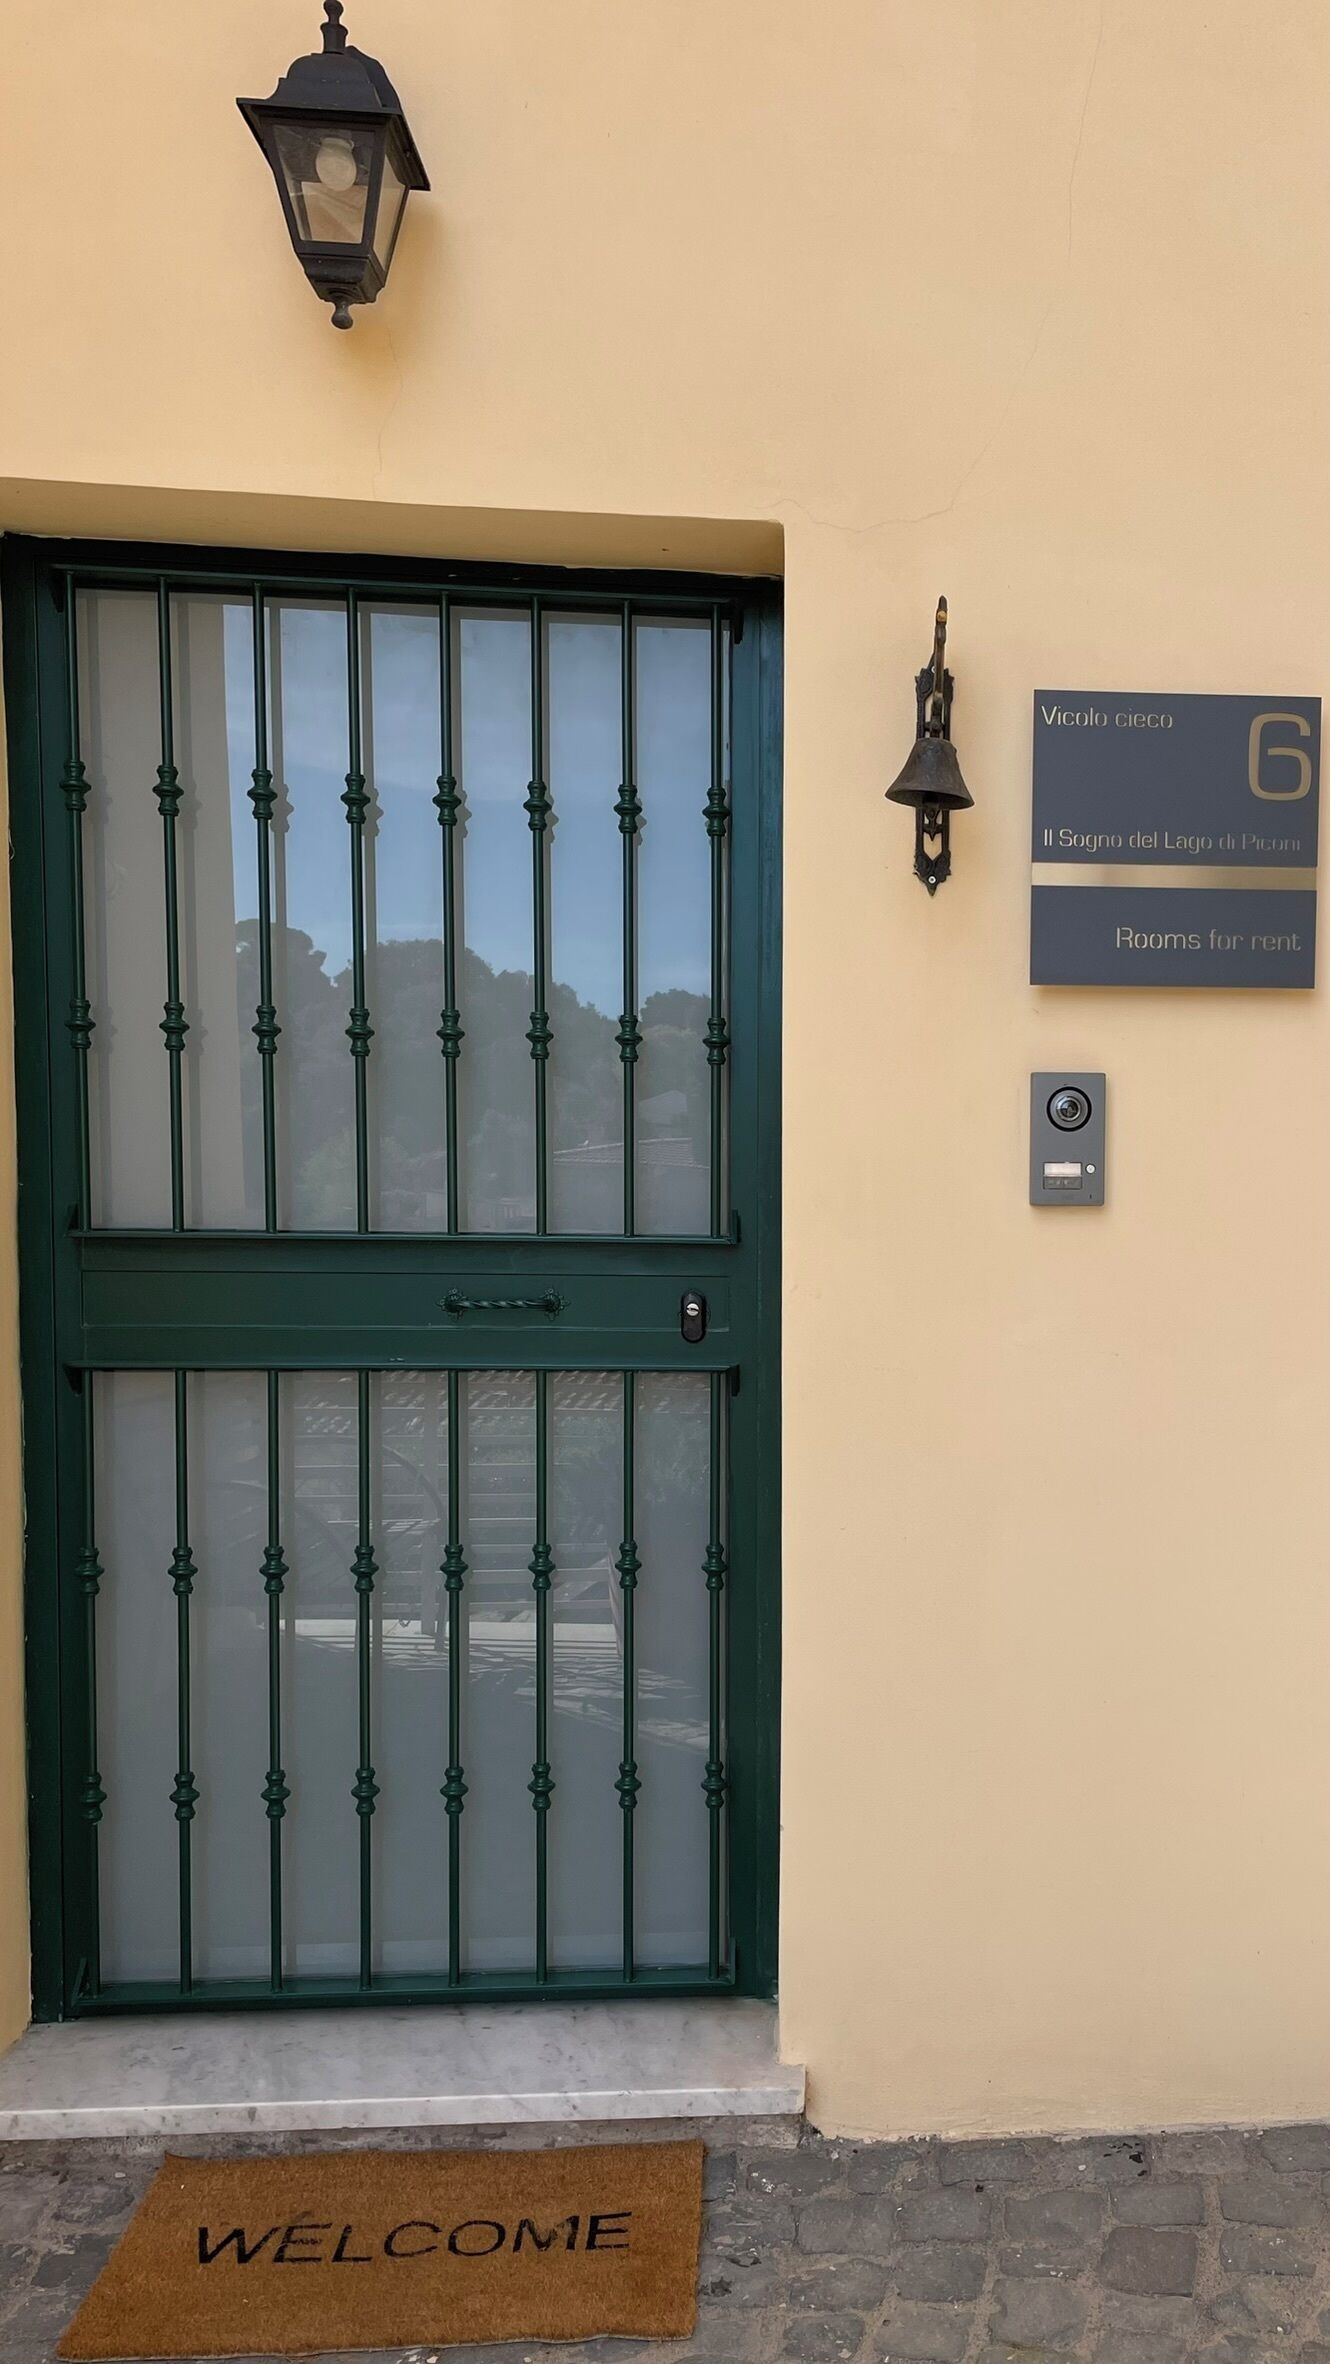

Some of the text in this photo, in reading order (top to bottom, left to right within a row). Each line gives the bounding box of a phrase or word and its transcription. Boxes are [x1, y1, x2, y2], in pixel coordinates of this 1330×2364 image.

[1041, 705, 1173, 728] Vicolo cieco
[1248, 712, 1312, 801] 6
[1043, 829, 1052, 847] Il
[1059, 829, 1122, 853] Sogno
[1129, 831, 1157, 848] del
[1164, 832, 1213, 854] Lago
[1219, 833, 1235, 850] di
[1116, 927, 1301, 951] Rooms for rent
[198, 2211, 632, 2264] WELCOME
